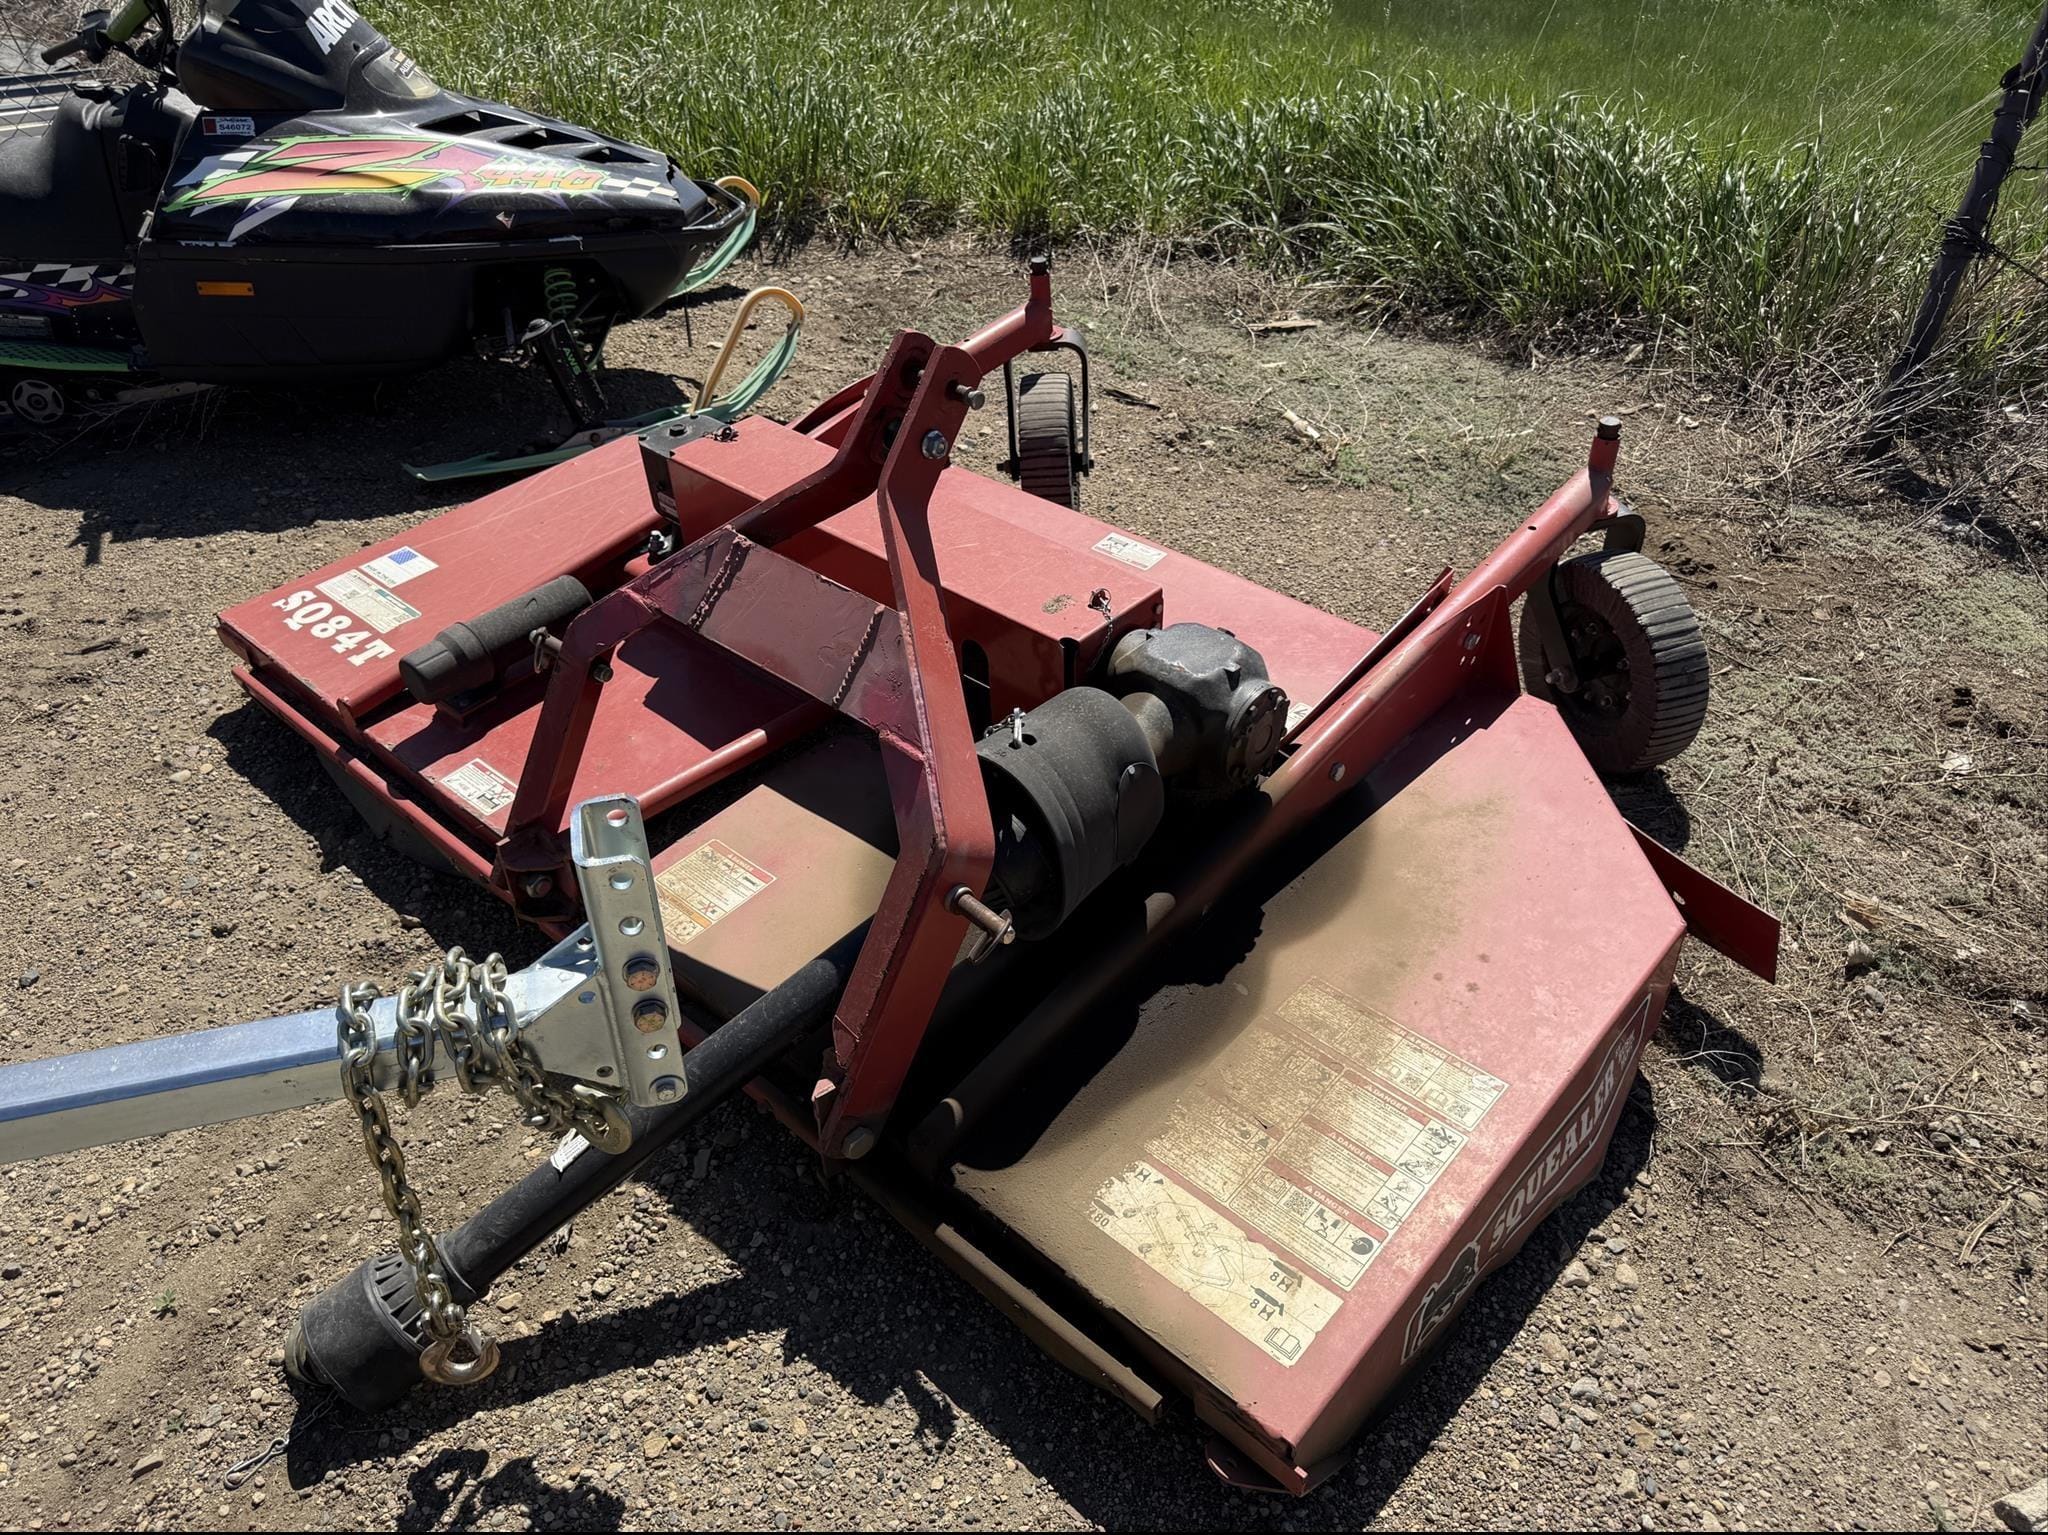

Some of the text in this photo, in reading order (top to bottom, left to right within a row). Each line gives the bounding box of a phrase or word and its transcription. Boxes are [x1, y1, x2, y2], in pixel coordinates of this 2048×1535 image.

[477, 156, 609, 192] 440
[562, 347, 582, 376] AWS
[272, 590, 396, 667] SQ84T
[1371, 1088, 1409, 1113] DANGER
[1334, 1135, 1373, 1162] DANGER
[1489, 1060, 1615, 1251] SQUEALER
[1312, 1188, 1351, 1216] DANGER
[1269, 1271, 1280, 1282] 8
[1249, 1298, 1260, 1309] 8
